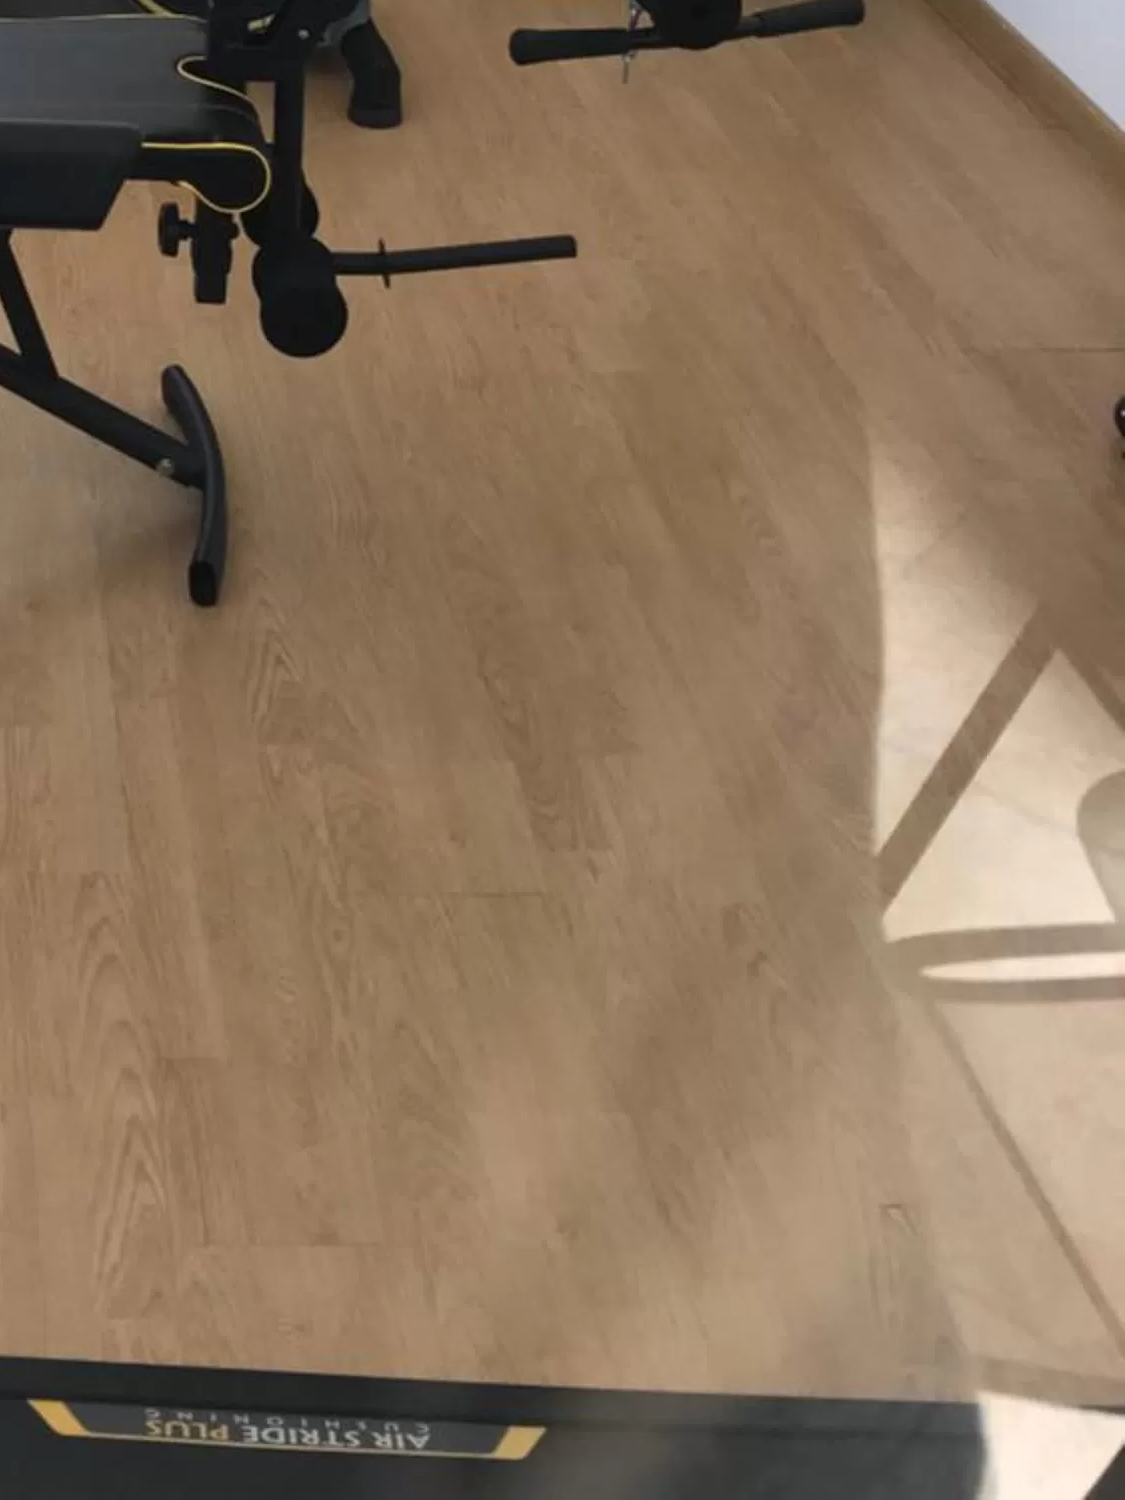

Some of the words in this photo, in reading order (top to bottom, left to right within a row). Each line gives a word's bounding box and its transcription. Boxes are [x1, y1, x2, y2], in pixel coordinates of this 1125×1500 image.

[143, 1407, 430, 1435] CUSHIONING
[145, 1418, 230, 1441] PLUS
[241, 1424, 361, 1448] STRIDE
[374, 1431, 431, 1450] AIR
